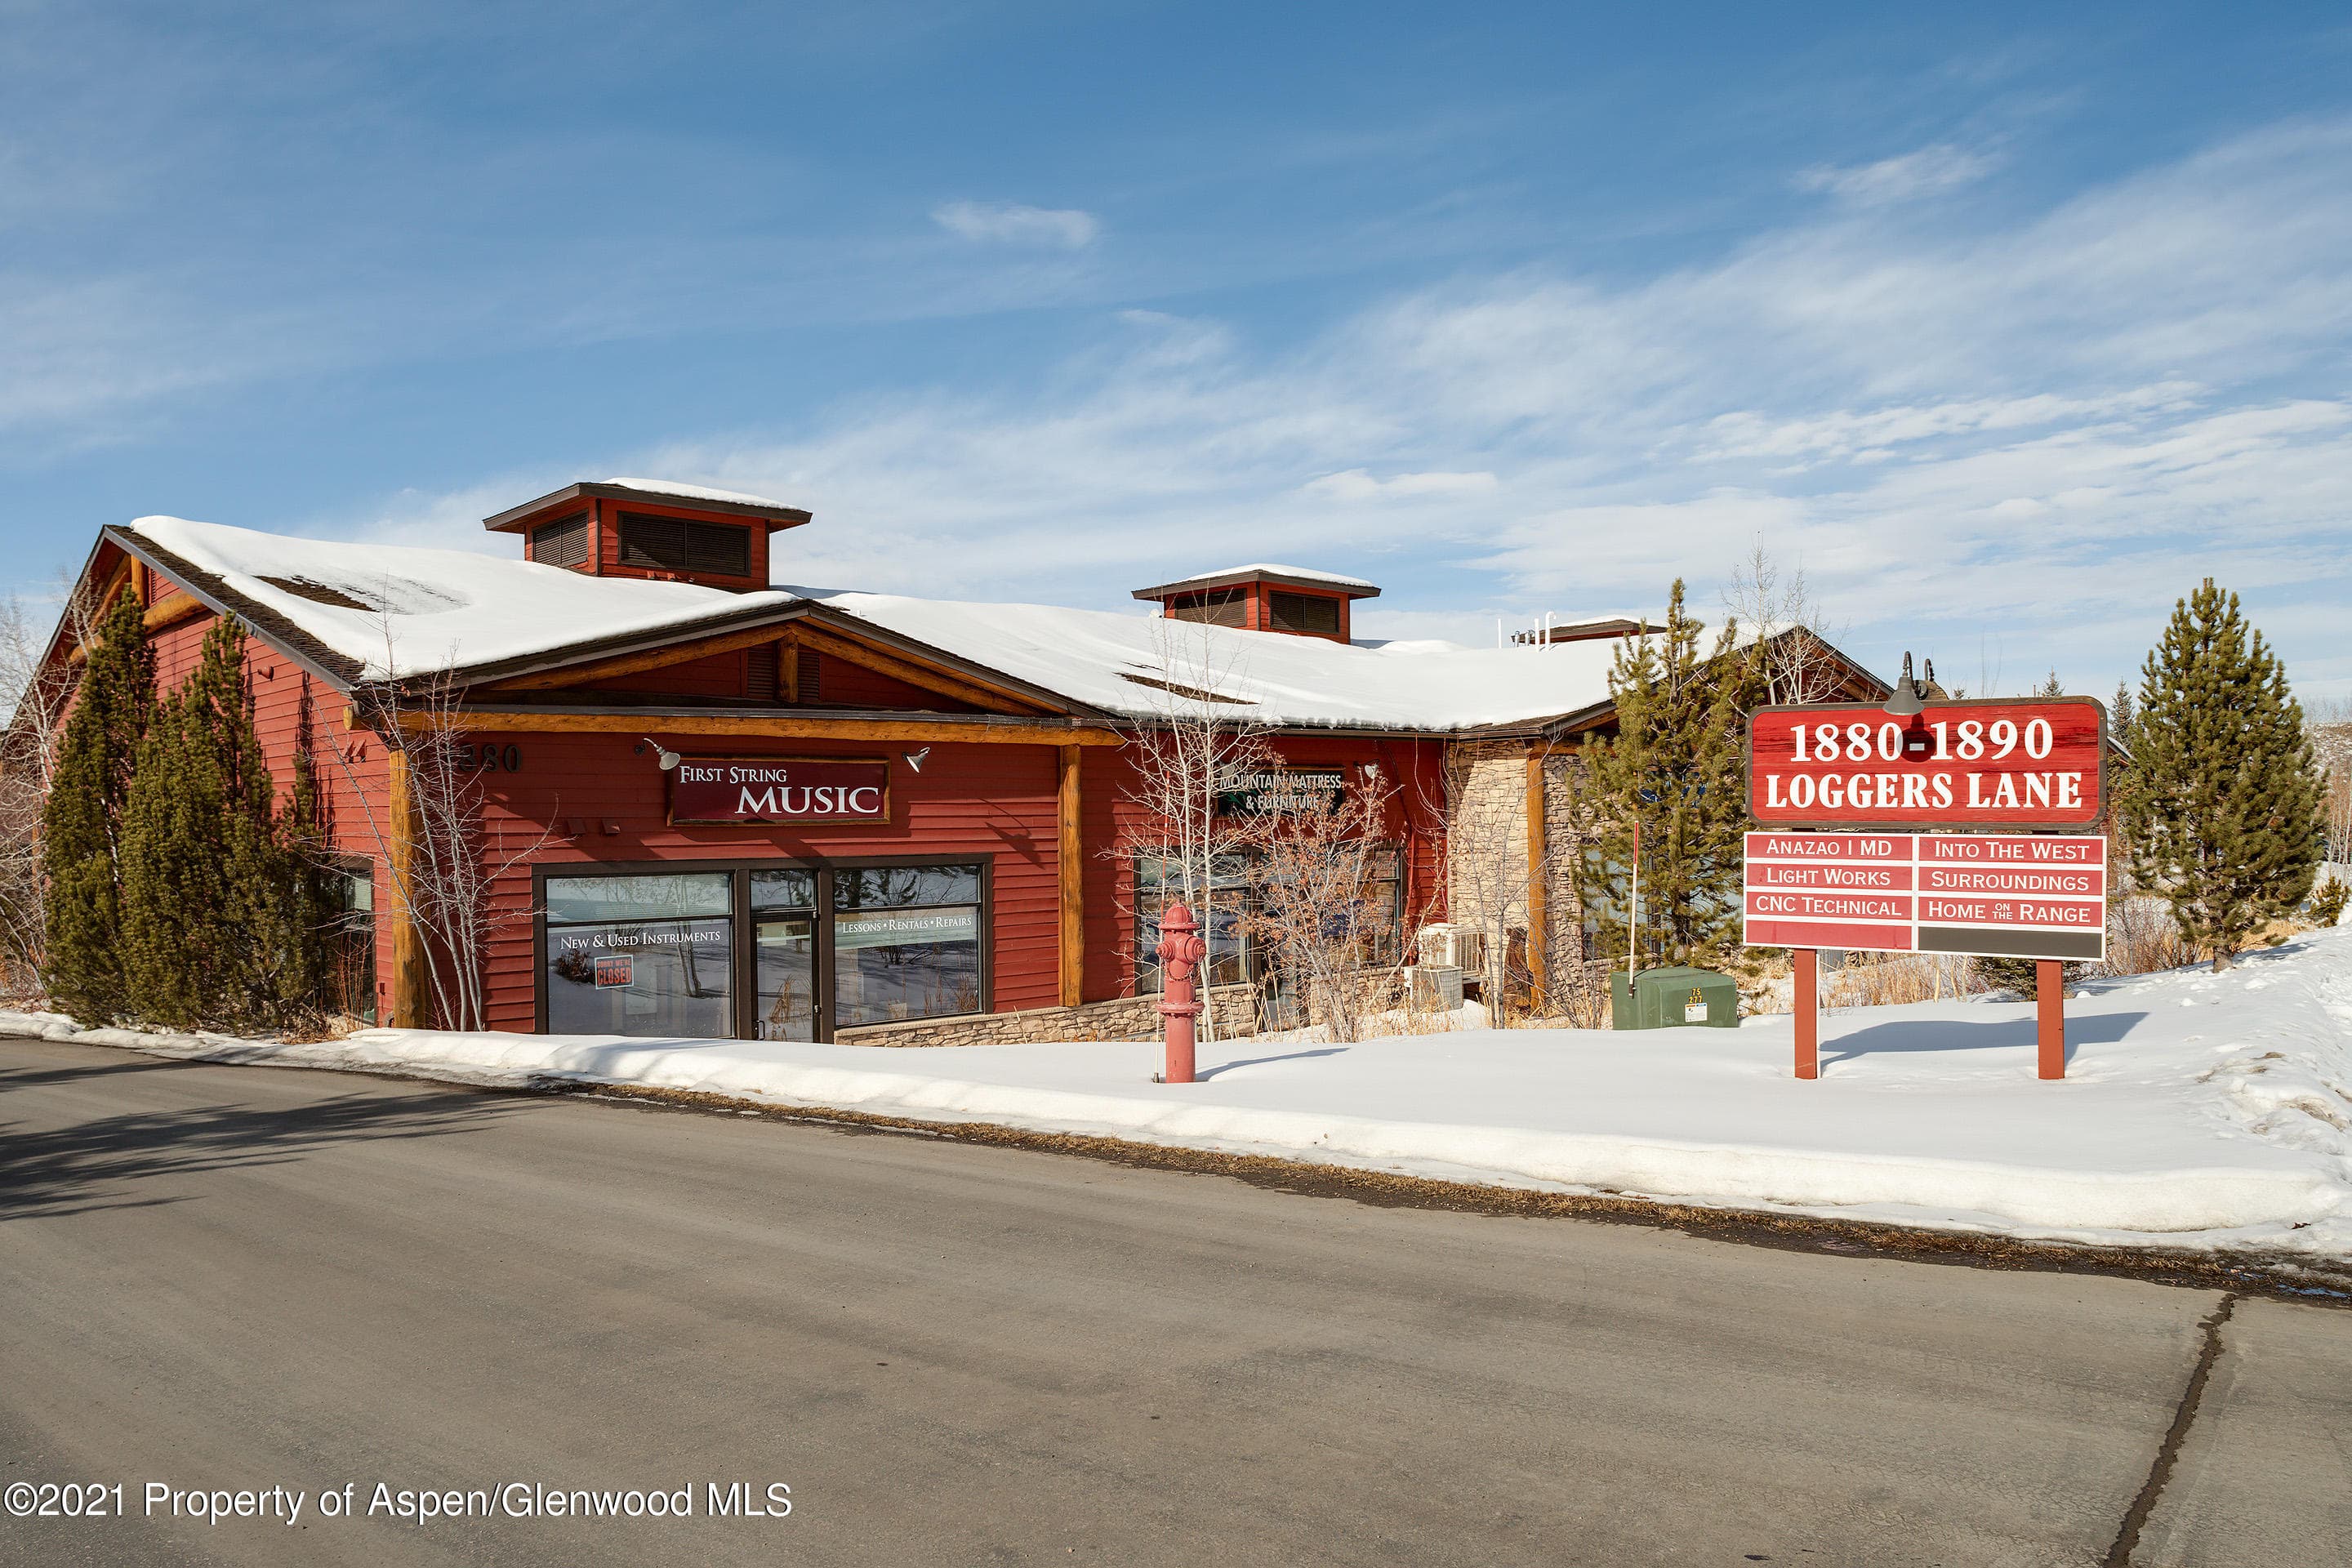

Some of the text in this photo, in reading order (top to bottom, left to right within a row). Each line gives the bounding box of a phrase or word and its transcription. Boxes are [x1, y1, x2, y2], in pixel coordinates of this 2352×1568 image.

[1789, 718, 2053, 763] 1880-1890
[679, 765, 788, 784] FIRST STRING
[1289, 774, 1342, 789] MATTRESS
[733, 786, 880, 814] MUSIC
[1765, 772, 2082, 808] LOGGERS LANE
[1245, 795, 1254, 809] &
[1766, 839, 1840, 855] ANAZAO
[1860, 840, 1892, 856] MD
[1934, 840, 2090, 860] INTO THE WEST
[1766, 866, 1891, 886] LIGHT WORKS
[1931, 871, 2089, 891] SURROUNDINGS
[1756, 895, 1902, 915] CNC TECHNICAL
[1928, 901, 2091, 923] HOME ON THE RANGE
[842, 916, 972, 933] LESSONS RENTALS REPAIRS
[560, 930, 720, 950] NEW & USED INSTRUMENTS
[597, 967, 632, 987] CLOSED
